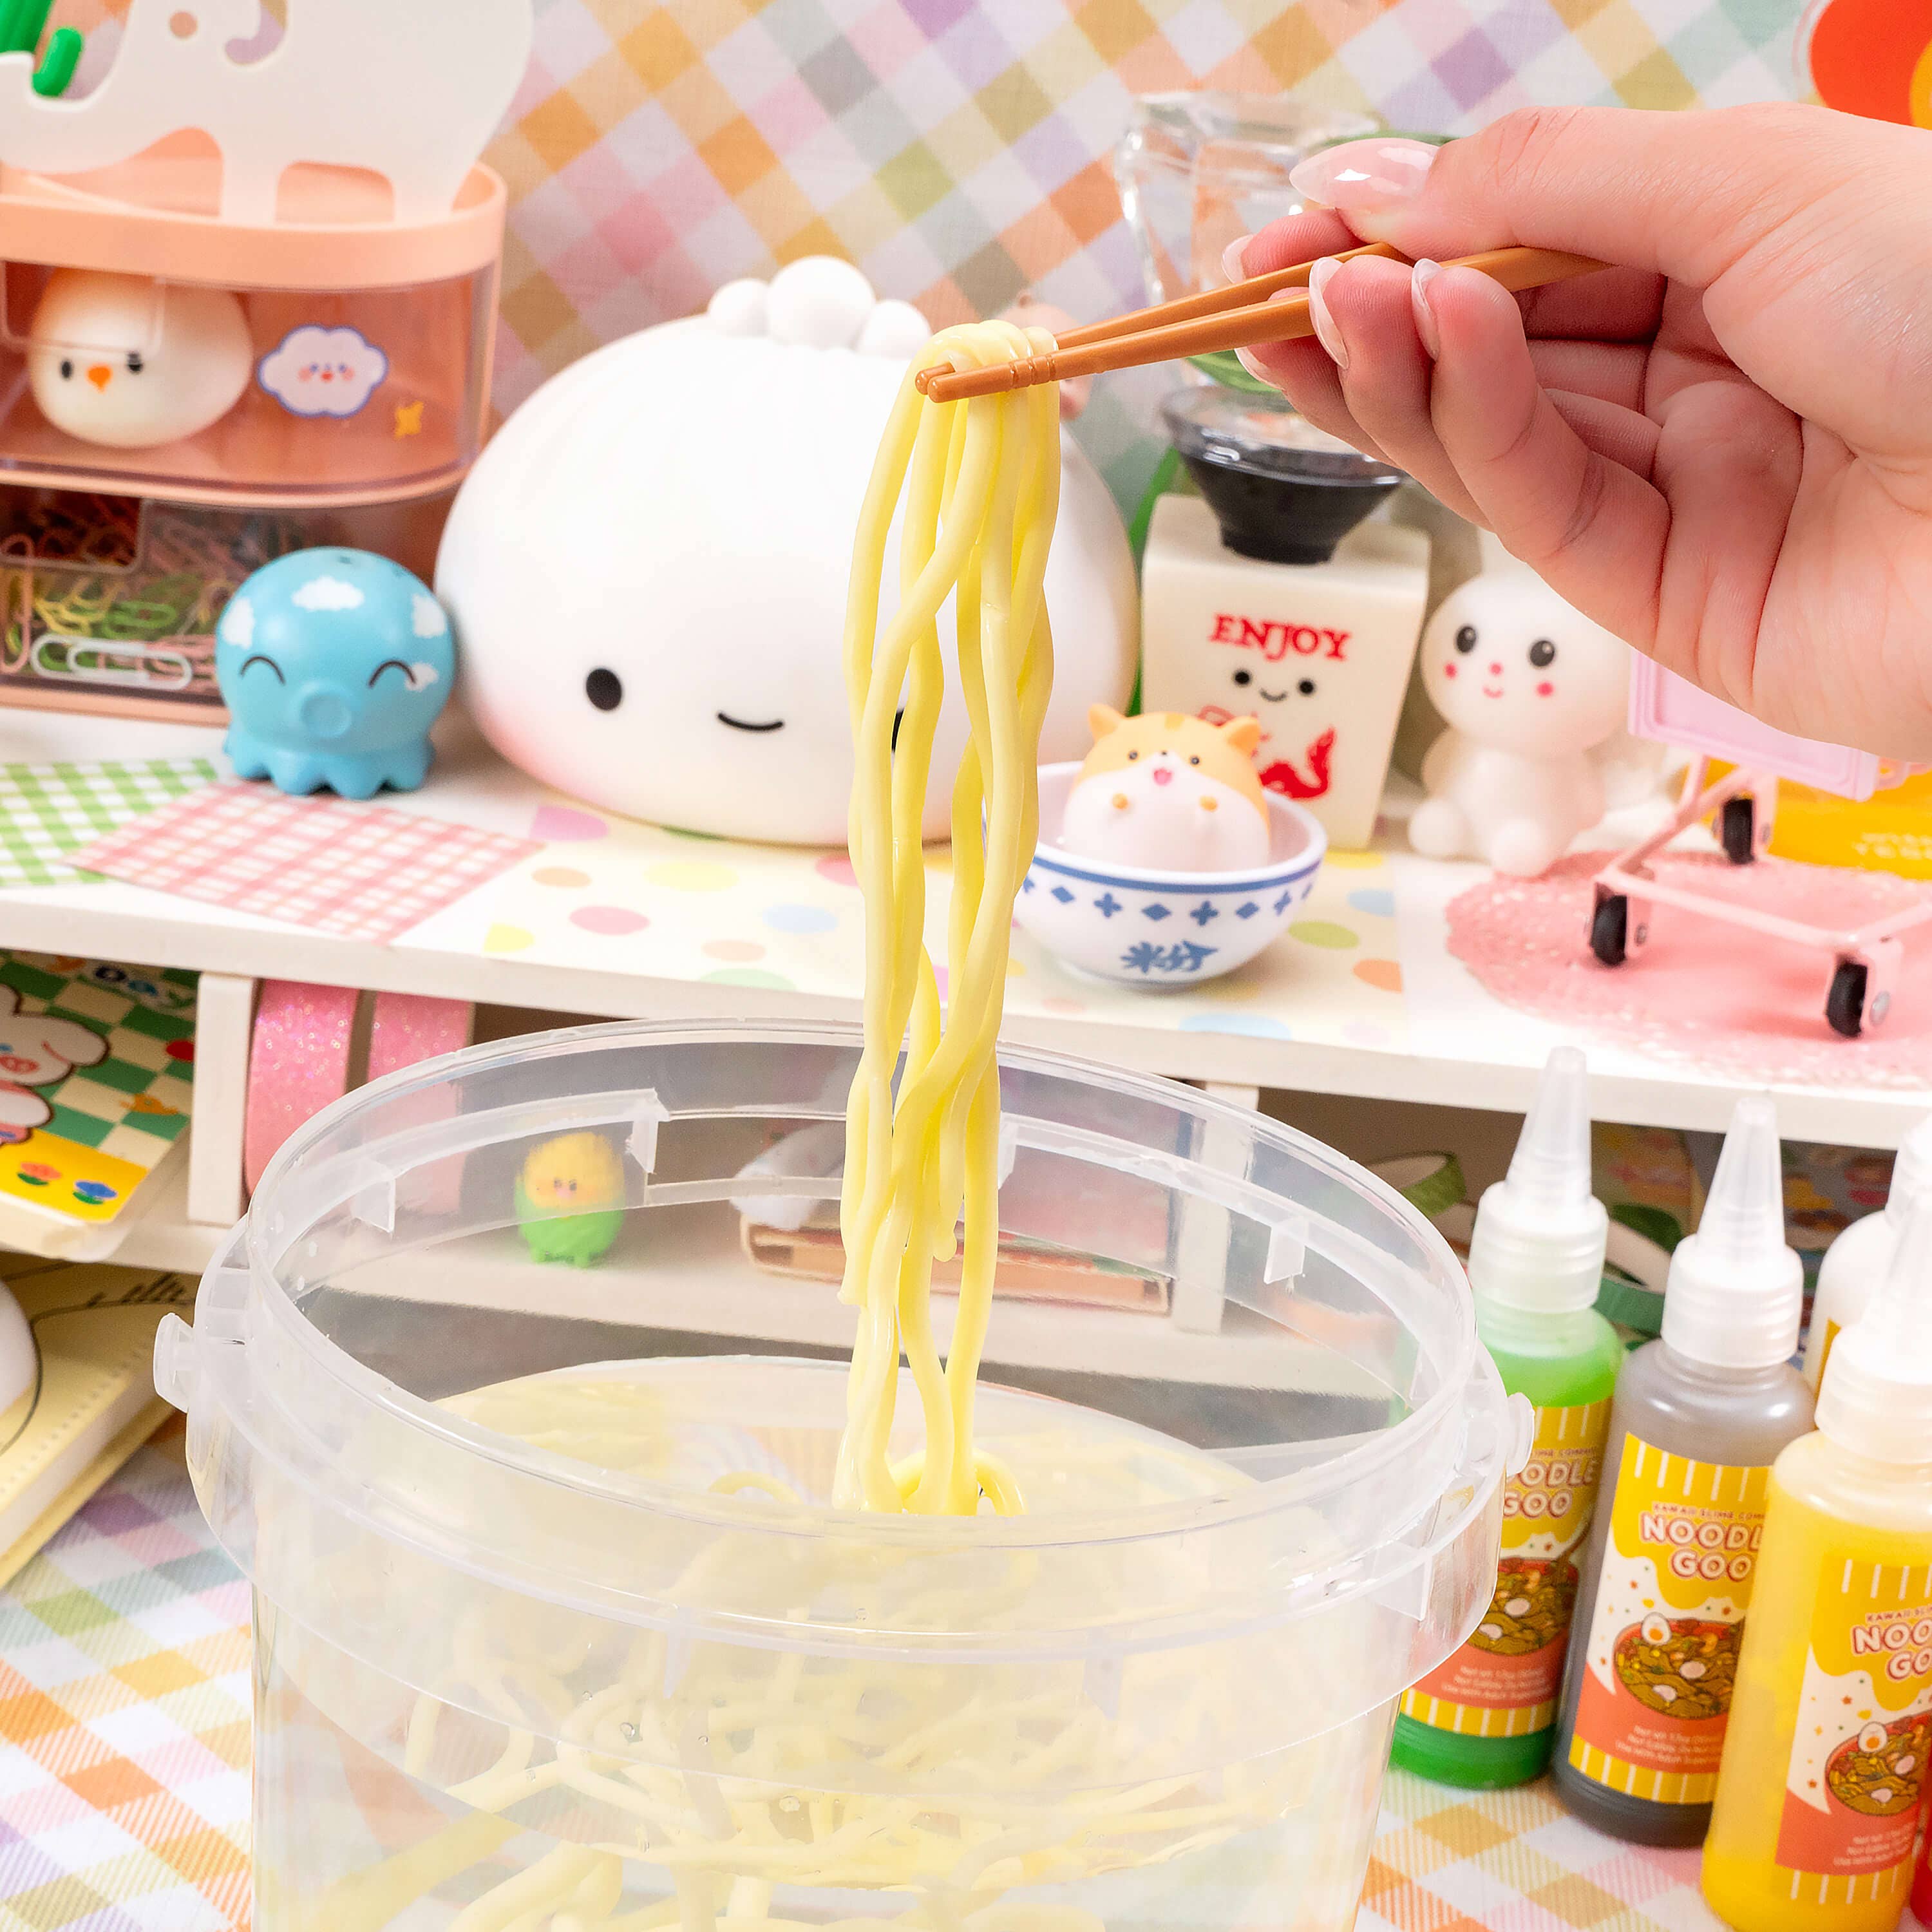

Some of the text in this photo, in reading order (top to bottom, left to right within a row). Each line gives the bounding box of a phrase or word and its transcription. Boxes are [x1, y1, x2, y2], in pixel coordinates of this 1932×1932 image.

[1208, 613, 1351, 662] ENJOY
[1641, 1511, 1764, 1552] NOODL
[1669, 1547, 1757, 1583] GOO
